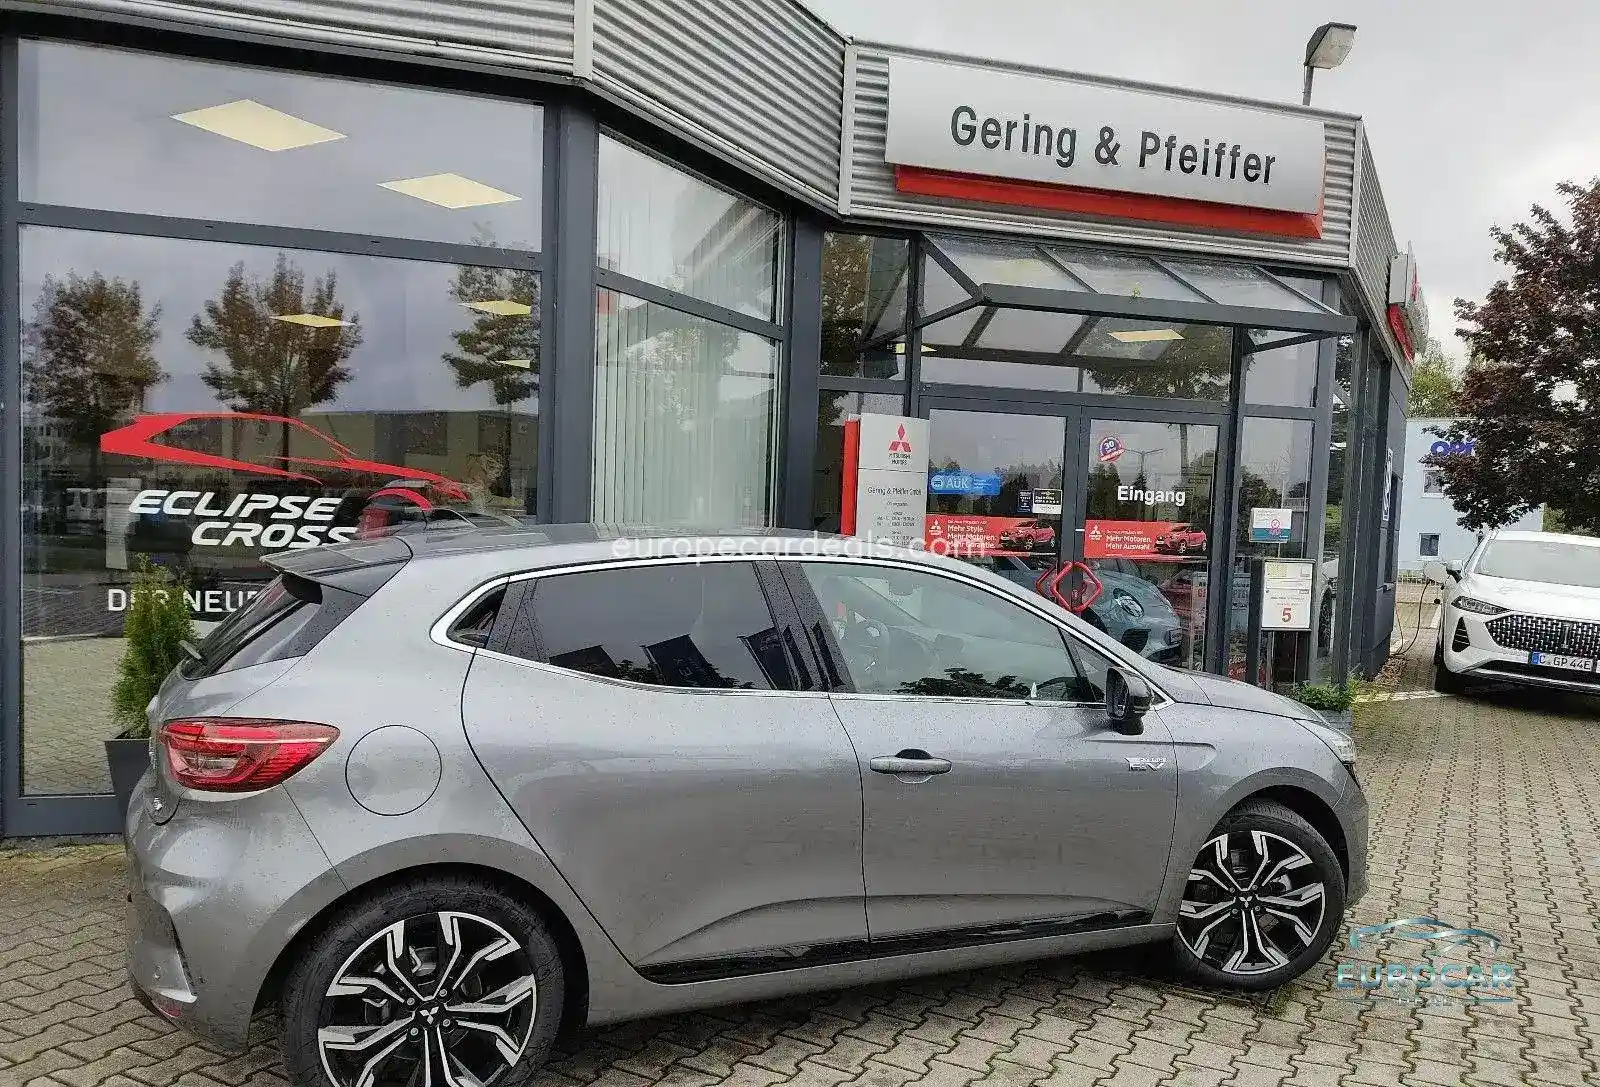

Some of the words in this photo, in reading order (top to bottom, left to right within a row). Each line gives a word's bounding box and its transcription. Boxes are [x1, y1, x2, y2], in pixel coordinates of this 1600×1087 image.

[951, 105, 1077, 169] Gering
[1094, 125, 1121, 167] &
[1139, 130, 1277, 185] Pfeiffer
[1117, 485, 1186, 507] Eingang
[128, 489, 344, 521] ECLIPSE
[191, 521, 359, 549] CROSS
[947, 524, 965, 532] Mehr
[966, 525, 985, 534] Style.
[947, 532, 965, 540] Mehr
[965, 533, 997, 542] Motoren.
[1106, 534, 1123, 542] Mehr
[1123, 535, 1153, 543] Motoren.
[1105, 542, 1122, 550] Mehr
[1281, 607, 1292, 623] 5
[1553, 656, 1568, 667] GP
[1569, 658, 1591, 671] 44E
